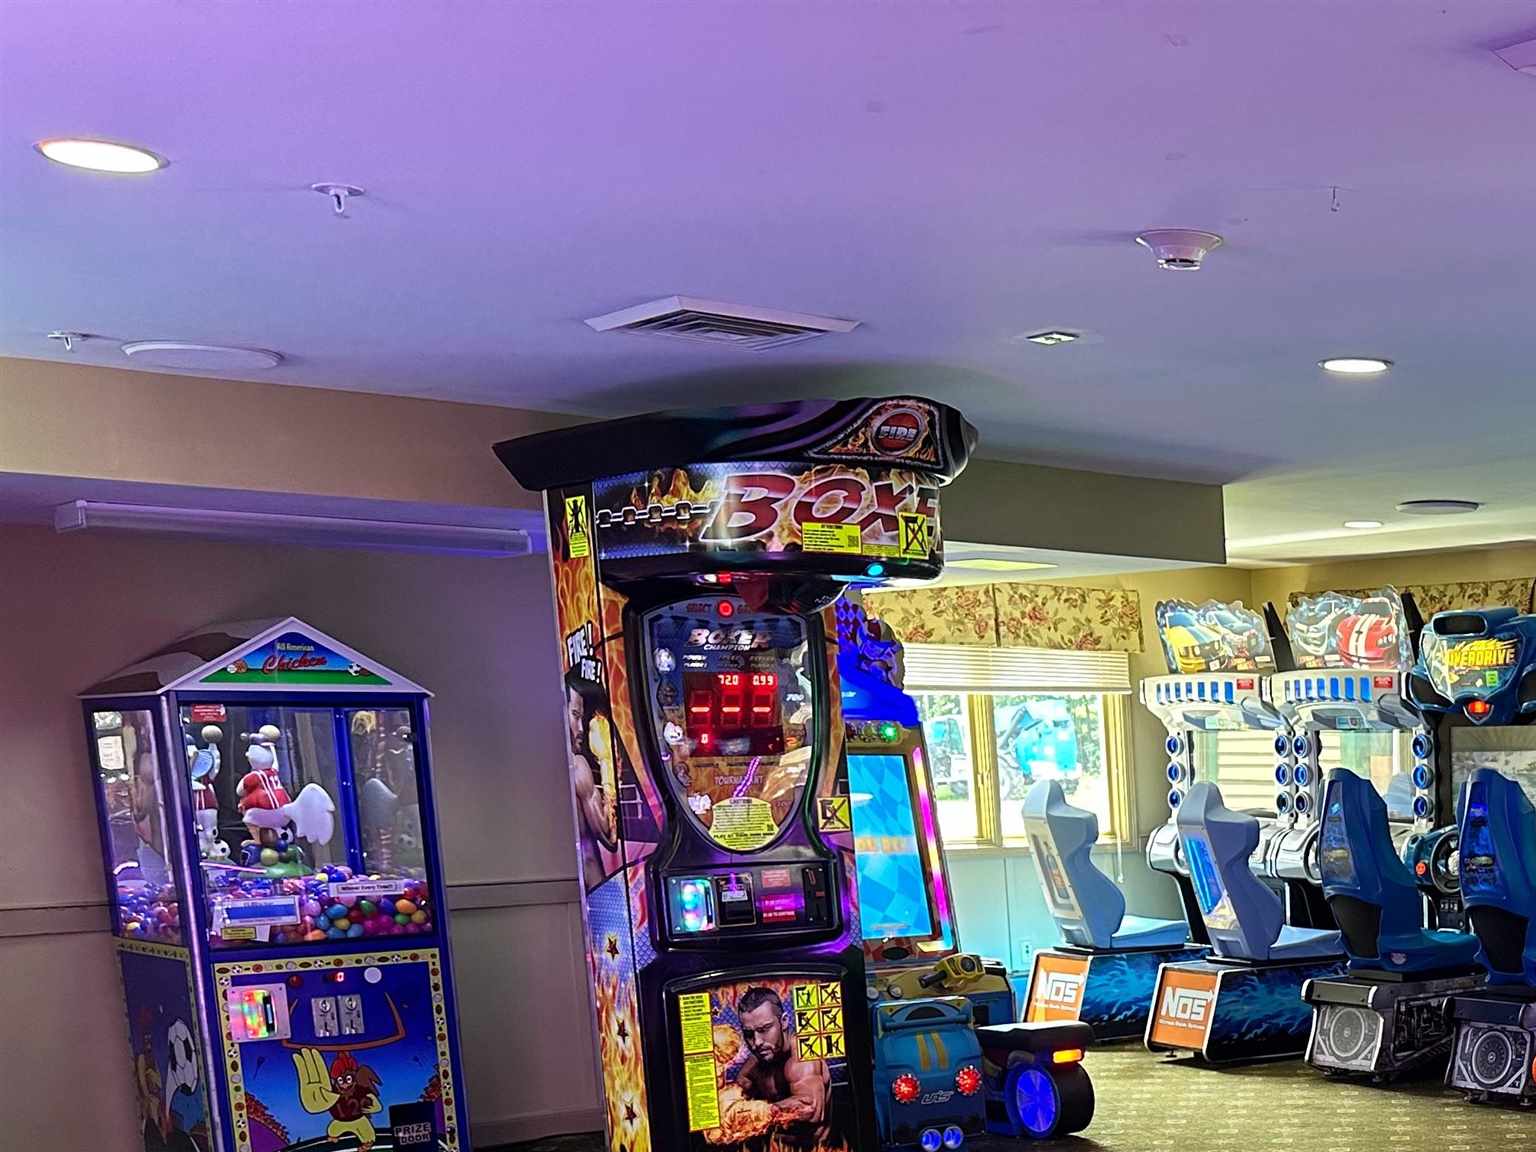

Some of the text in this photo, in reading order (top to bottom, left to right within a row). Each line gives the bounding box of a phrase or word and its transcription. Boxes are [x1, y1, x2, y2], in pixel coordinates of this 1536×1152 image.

[878, 425, 917, 441] FIRE
[703, 643, 751, 651] CHAMPION
[1037, 969, 1083, 1003] NOS
[1160, 986, 1212, 1022] NOS
[393, 1122, 432, 1137] PRIZE
[400, 1132, 432, 1145] DOOR
